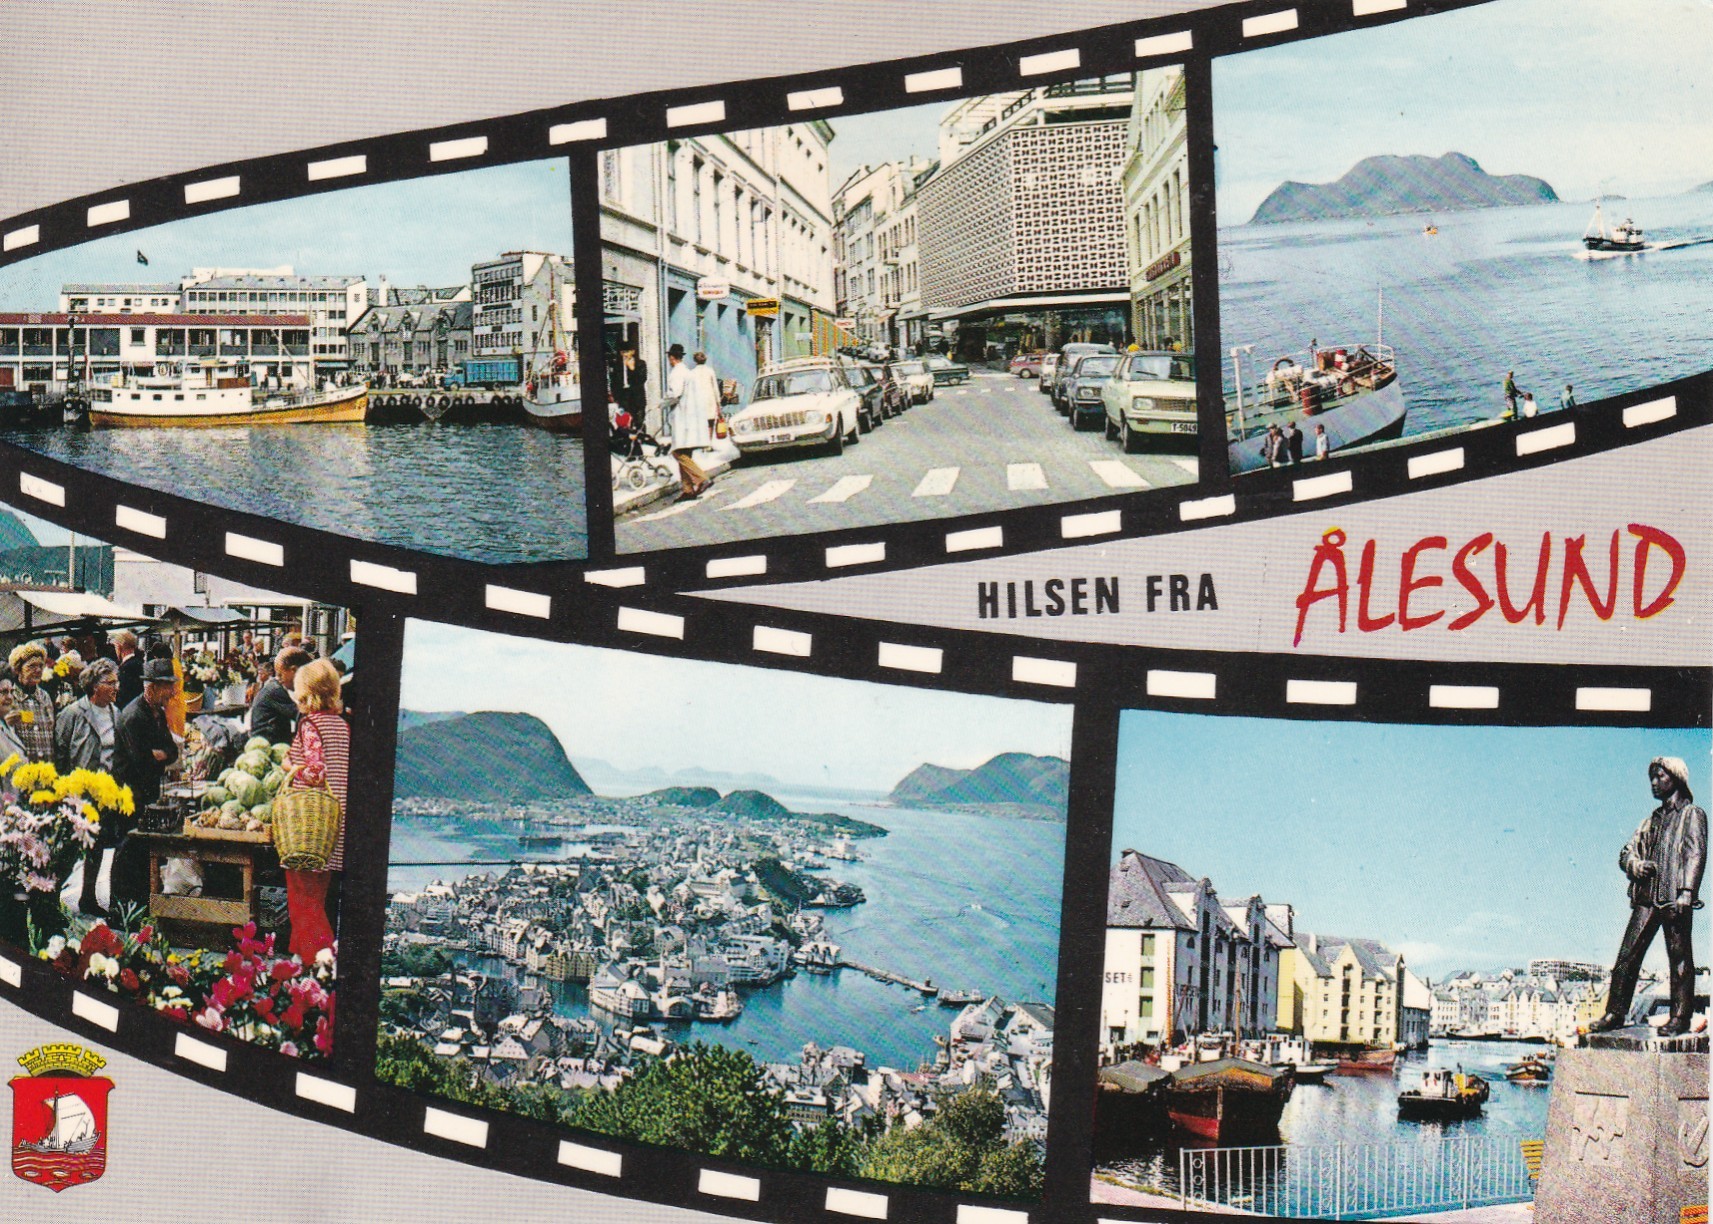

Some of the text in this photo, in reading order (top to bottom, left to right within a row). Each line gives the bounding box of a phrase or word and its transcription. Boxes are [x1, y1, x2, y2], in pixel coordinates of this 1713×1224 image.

[978, 523, 1686, 647] HILSEN FRA ÅLESUND
